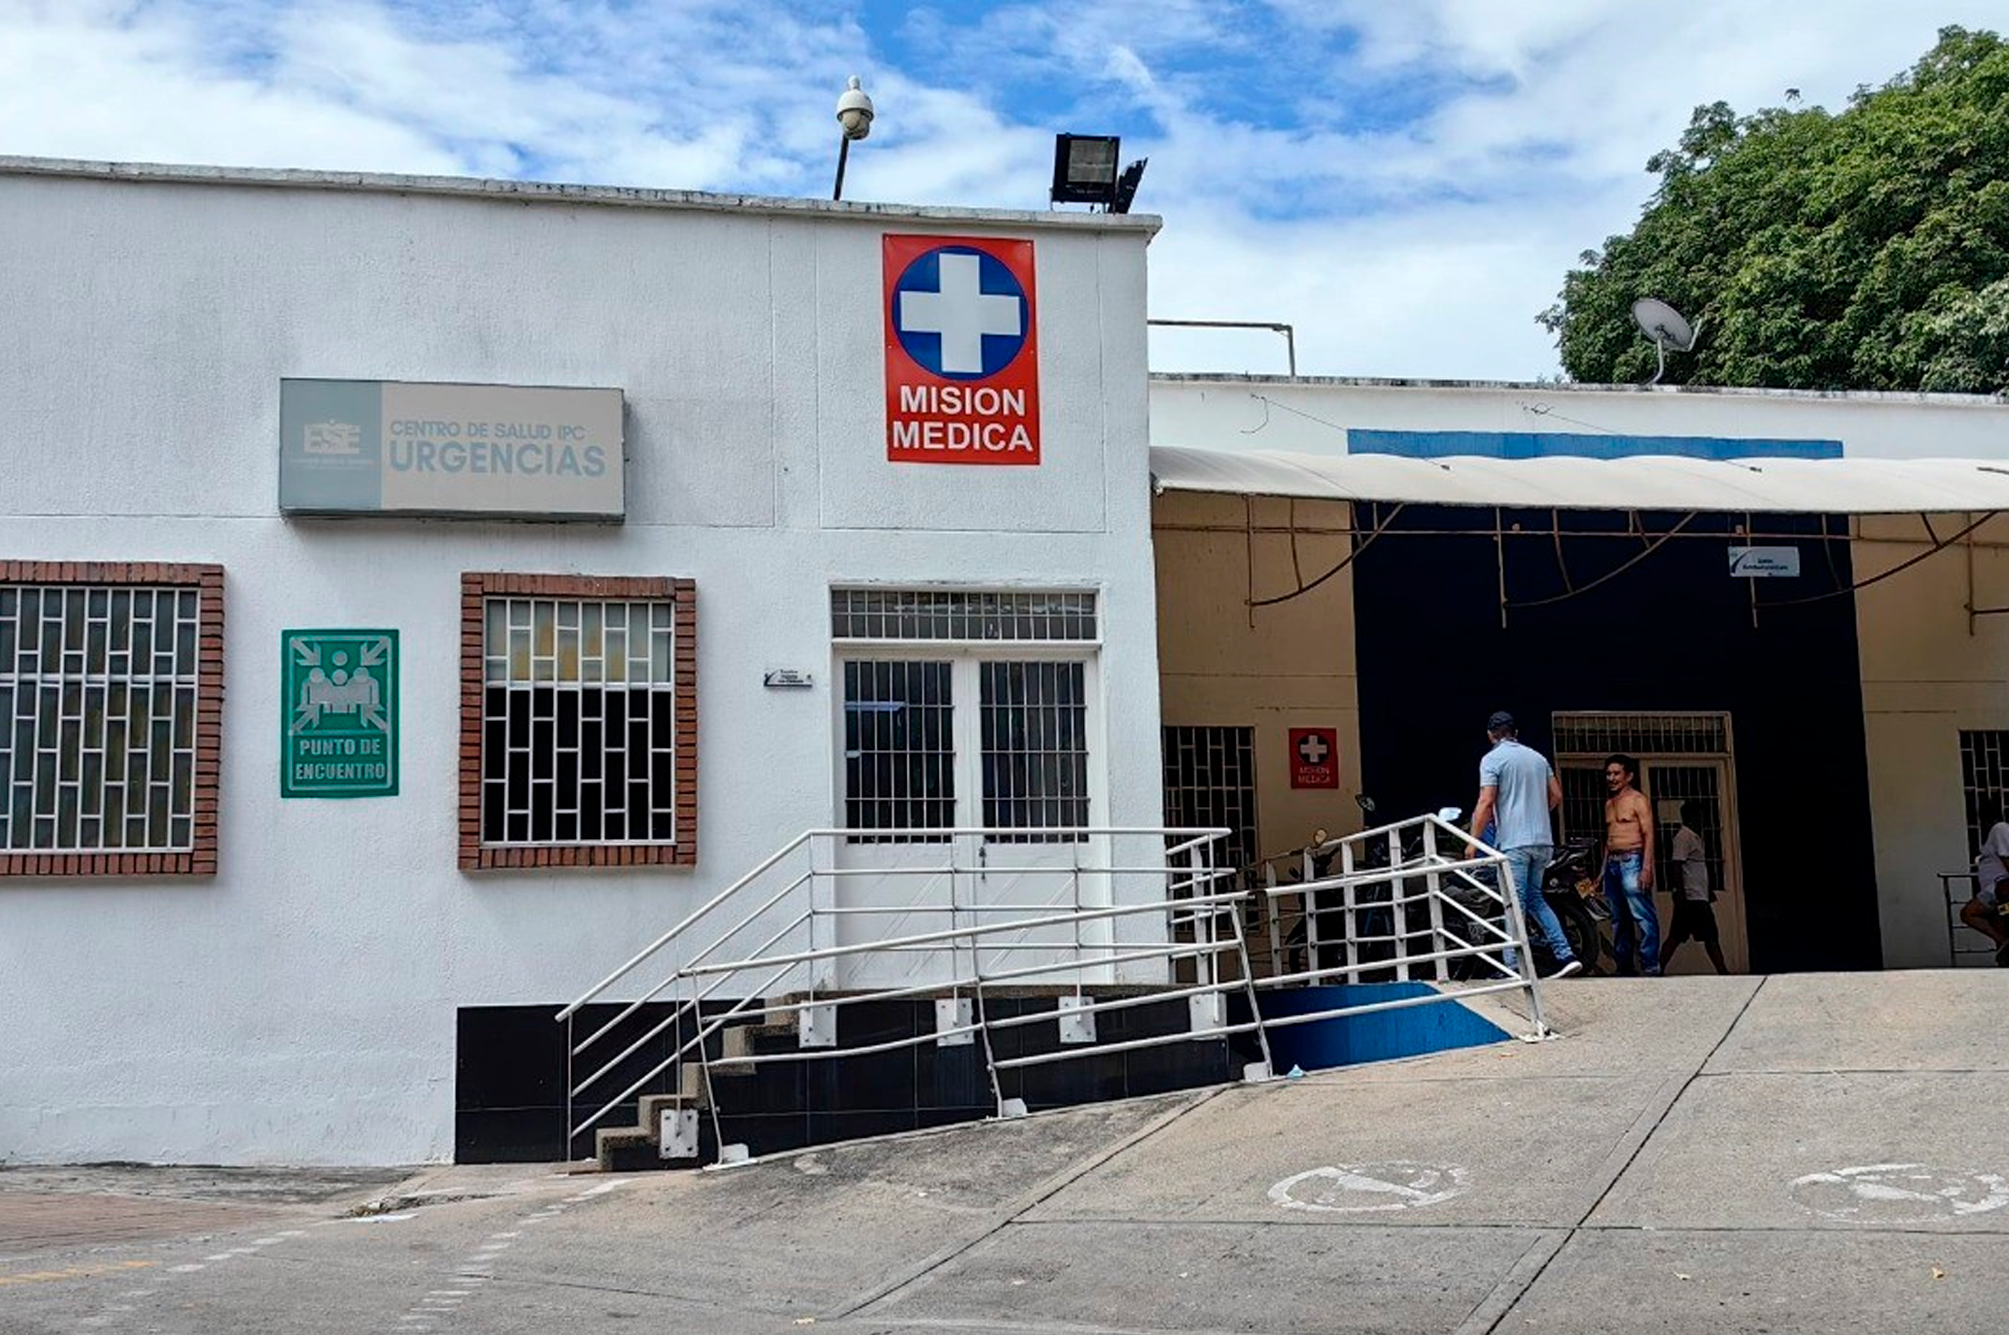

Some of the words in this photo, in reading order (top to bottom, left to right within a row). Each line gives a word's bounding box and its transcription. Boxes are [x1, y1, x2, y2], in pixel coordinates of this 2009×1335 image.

[900, 385, 1026, 416] MISION
[390, 421, 461, 438] CENTRO
[467, 422, 489, 438] DE
[494, 423, 551, 440] SALUD
[557, 425, 586, 441] IPC
[893, 421, 1034, 451] MEDICA
[389, 440, 607, 477] URGENCIAS
[299, 738, 356, 755] PUNTO
[360, 738, 381, 754] DE
[295, 762, 386, 780] ENCUENTRO
